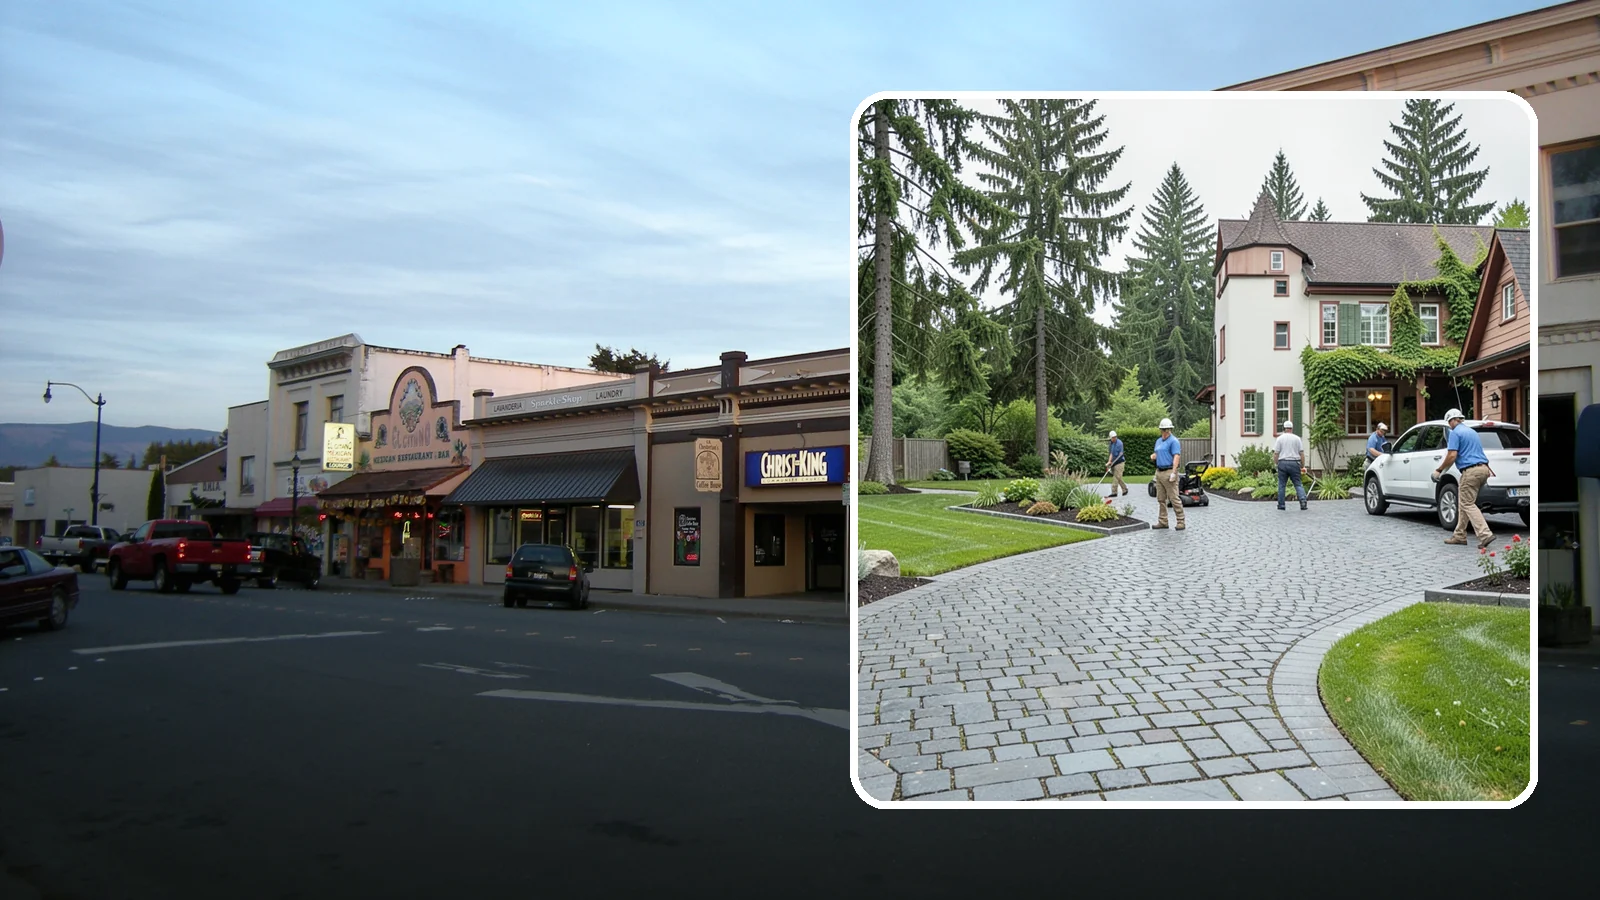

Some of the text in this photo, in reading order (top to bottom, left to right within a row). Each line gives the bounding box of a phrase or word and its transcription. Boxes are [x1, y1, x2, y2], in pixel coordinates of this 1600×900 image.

[494, 402, 522, 412] LAVANDERIA
[595, 389, 623, 399] LAUNDRY
[373, 455, 396, 464] MEXICAN
[397, 451, 434, 463] RESTAURANT
[437, 450, 450, 459] BAR
[761, 450, 828, 478] CHRIST KING
